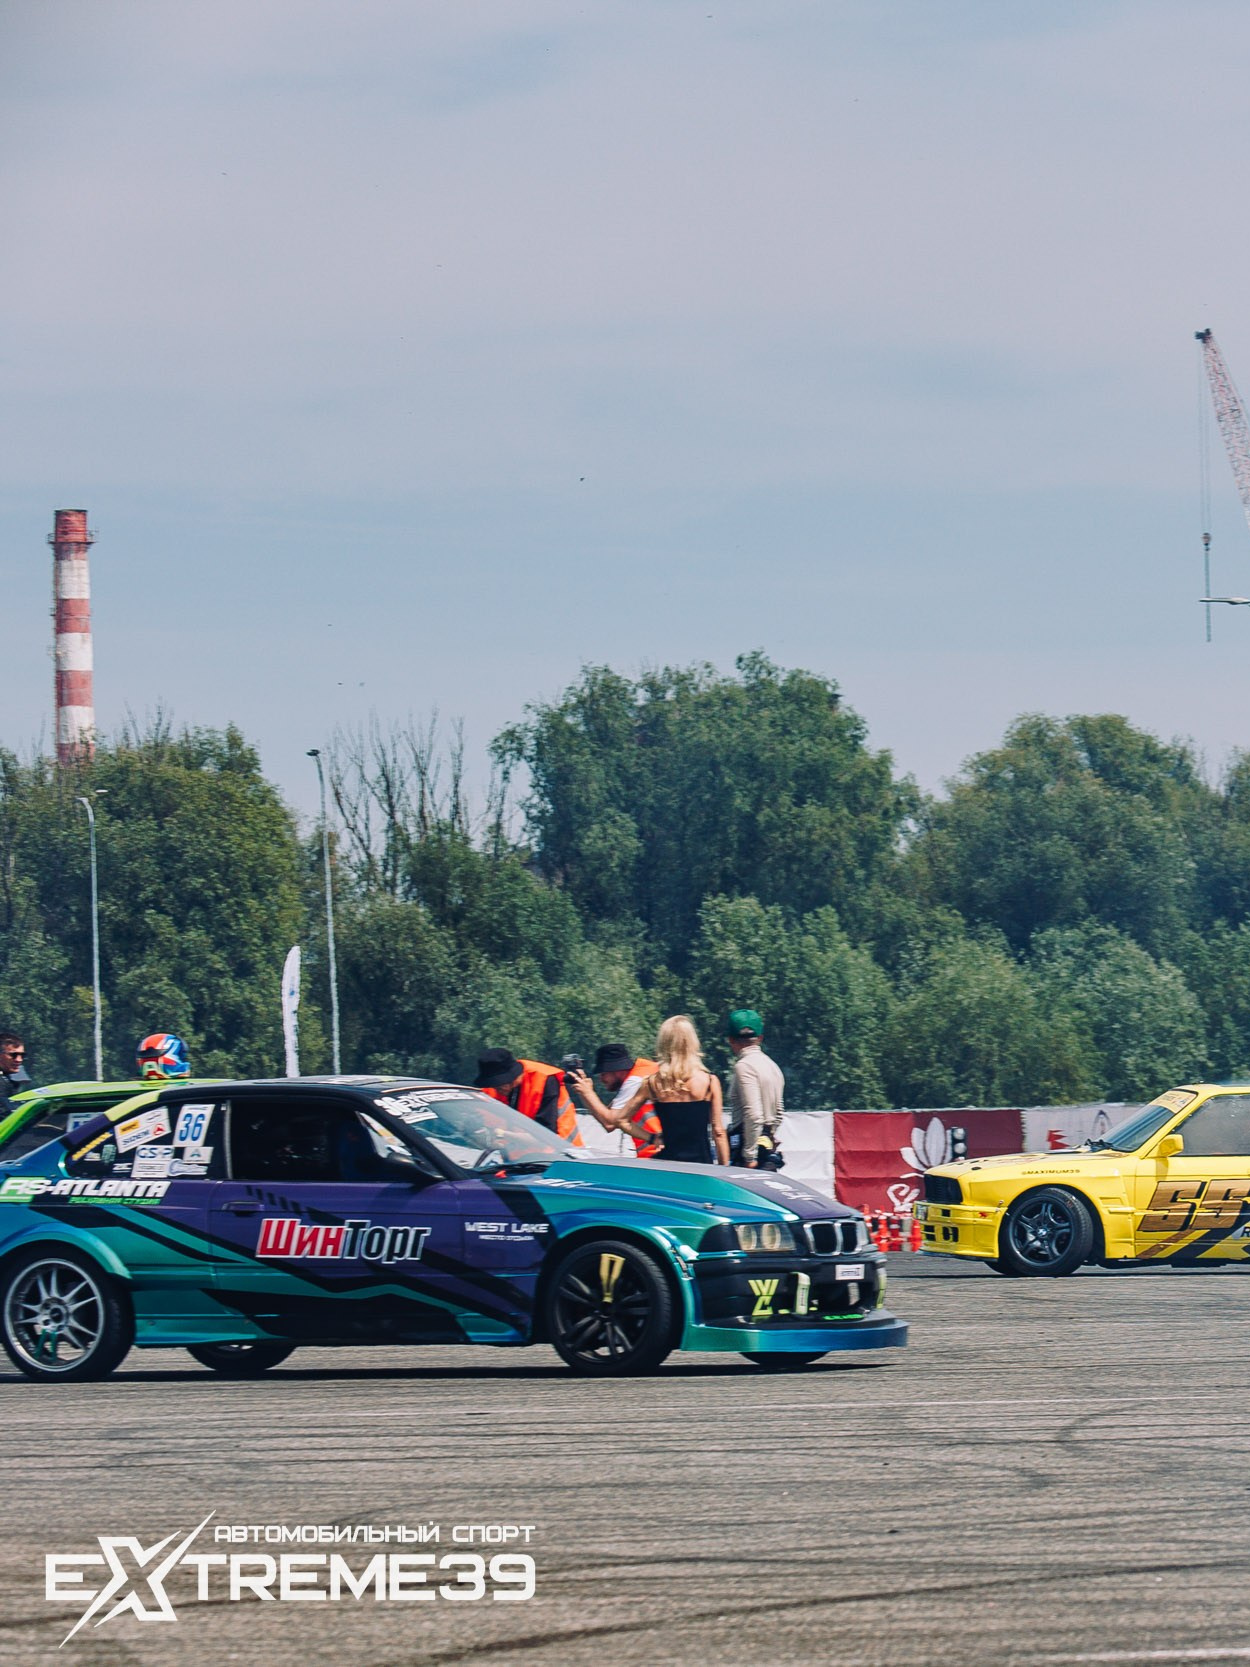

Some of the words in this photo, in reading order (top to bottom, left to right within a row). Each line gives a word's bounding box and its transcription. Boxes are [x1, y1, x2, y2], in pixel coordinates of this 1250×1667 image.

[179, 1113, 206, 1142] 36
[0, 1179, 171, 1198] RS-ATLANTA
[464, 1222, 509, 1232] WEST
[511, 1223, 549, 1233] LAKE
[255, 1218, 432, 1264] ШинТорг
